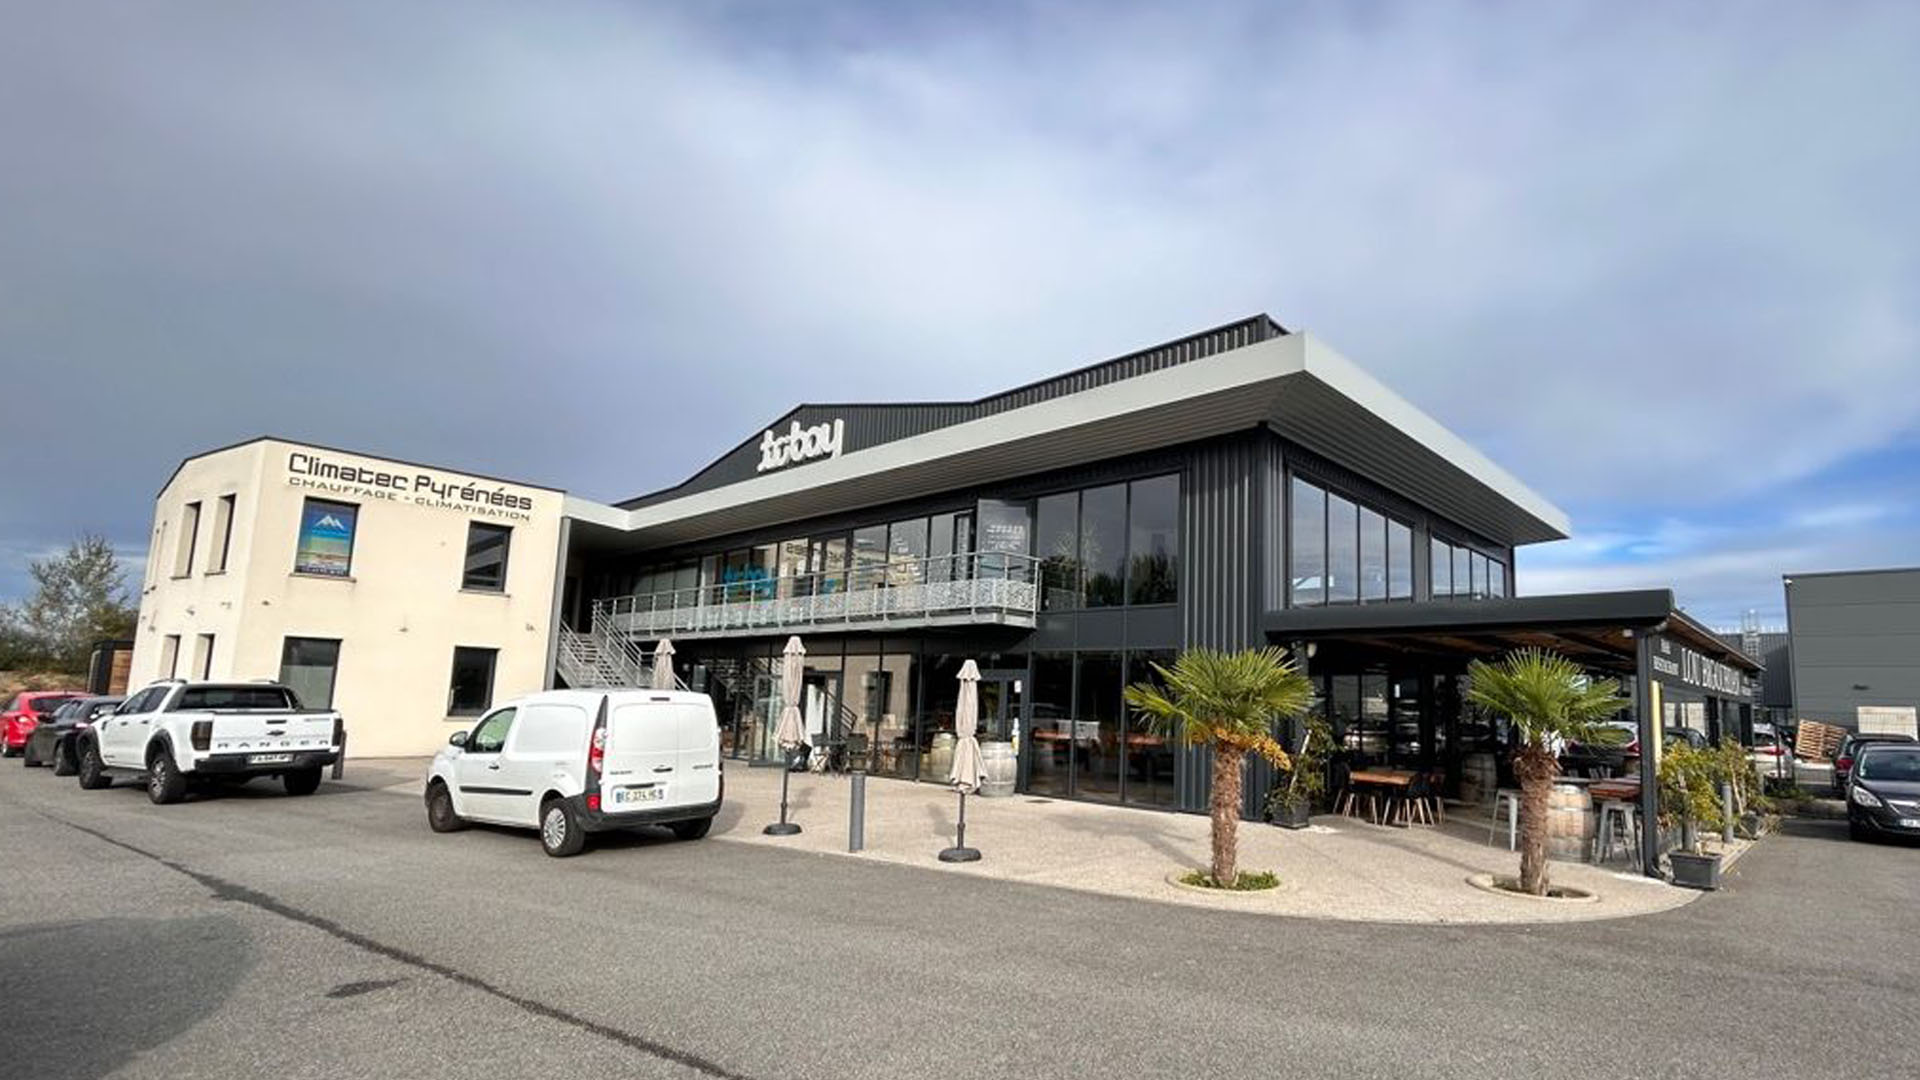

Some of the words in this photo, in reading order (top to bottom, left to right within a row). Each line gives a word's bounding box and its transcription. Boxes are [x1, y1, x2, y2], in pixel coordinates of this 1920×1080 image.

[289, 453, 409, 491] Climatec
[414, 475, 533, 510] Pyrénées
[289, 477, 398, 501] CHAUFFAGE
[415, 497, 531, 521] CLIMATISATION
